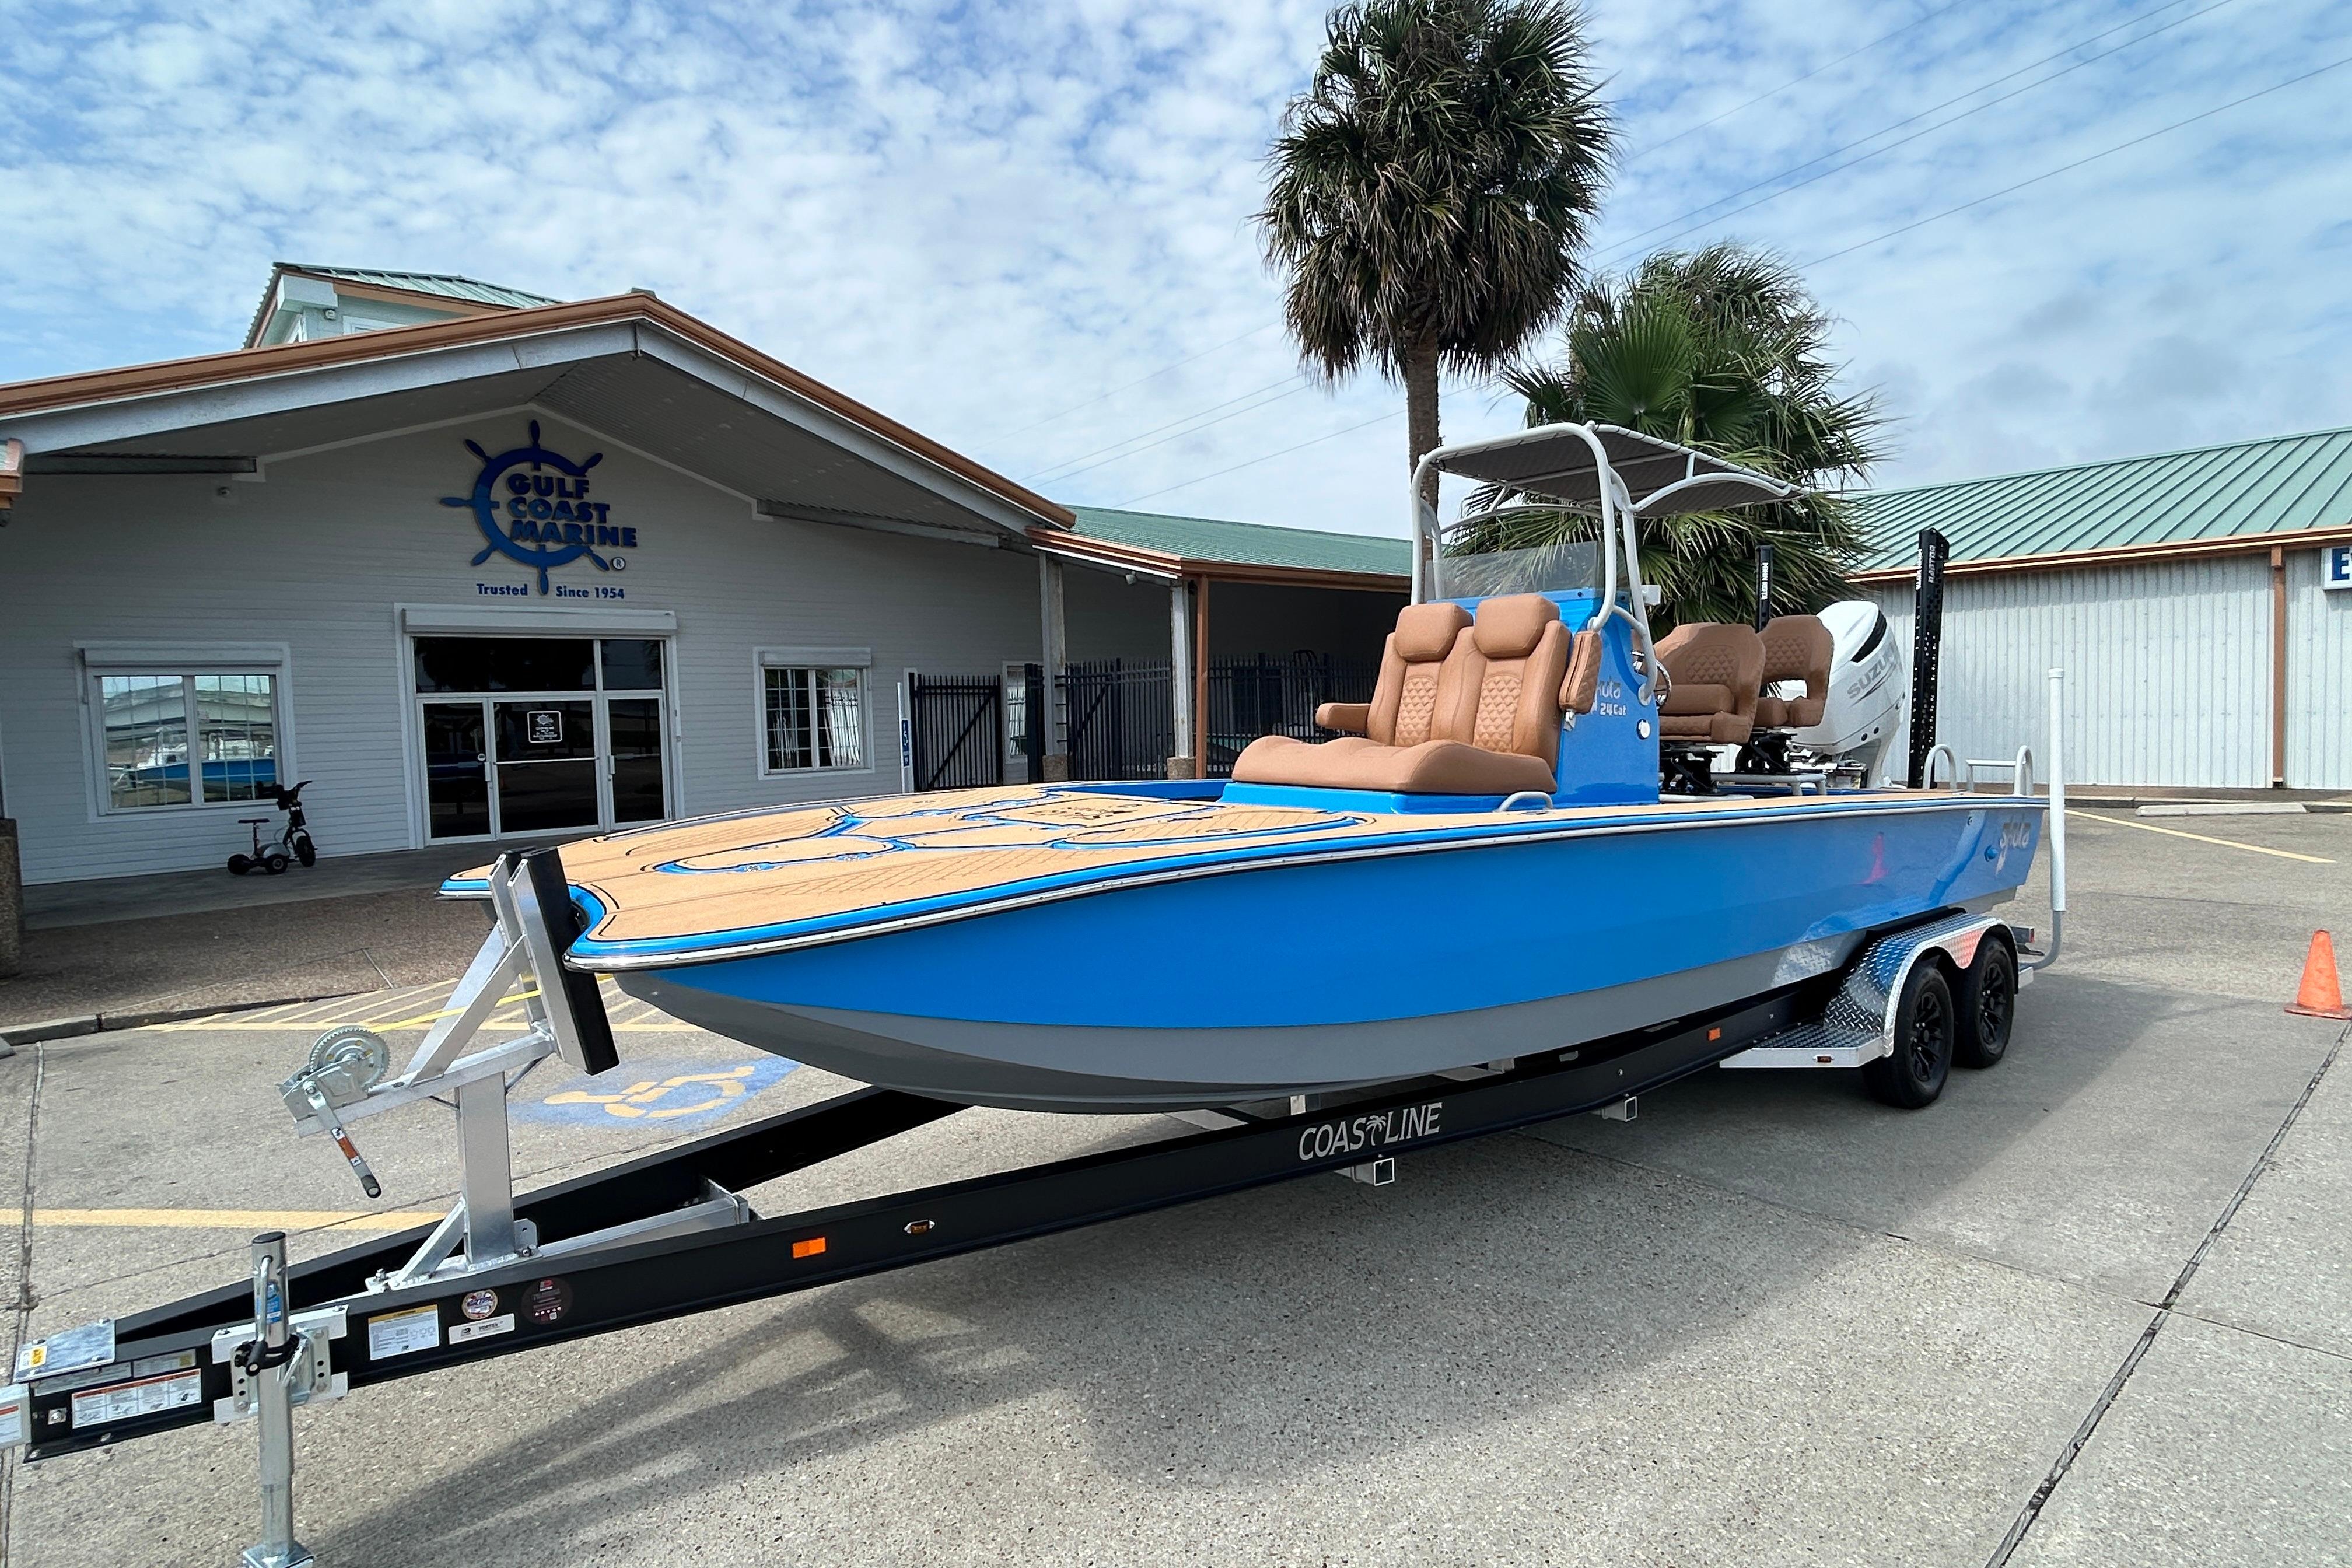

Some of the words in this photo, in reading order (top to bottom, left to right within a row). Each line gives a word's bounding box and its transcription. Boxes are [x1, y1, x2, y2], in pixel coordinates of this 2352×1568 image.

[507, 473, 589, 499] GULF
[507, 496, 610, 524] COAST
[510, 519, 638, 547] MARINE
[2332, 548, 2352, 580] E
[476, 583, 528, 596] Trusted
[555, 585, 589, 598] Since
[594, 587, 625, 599] 1954
